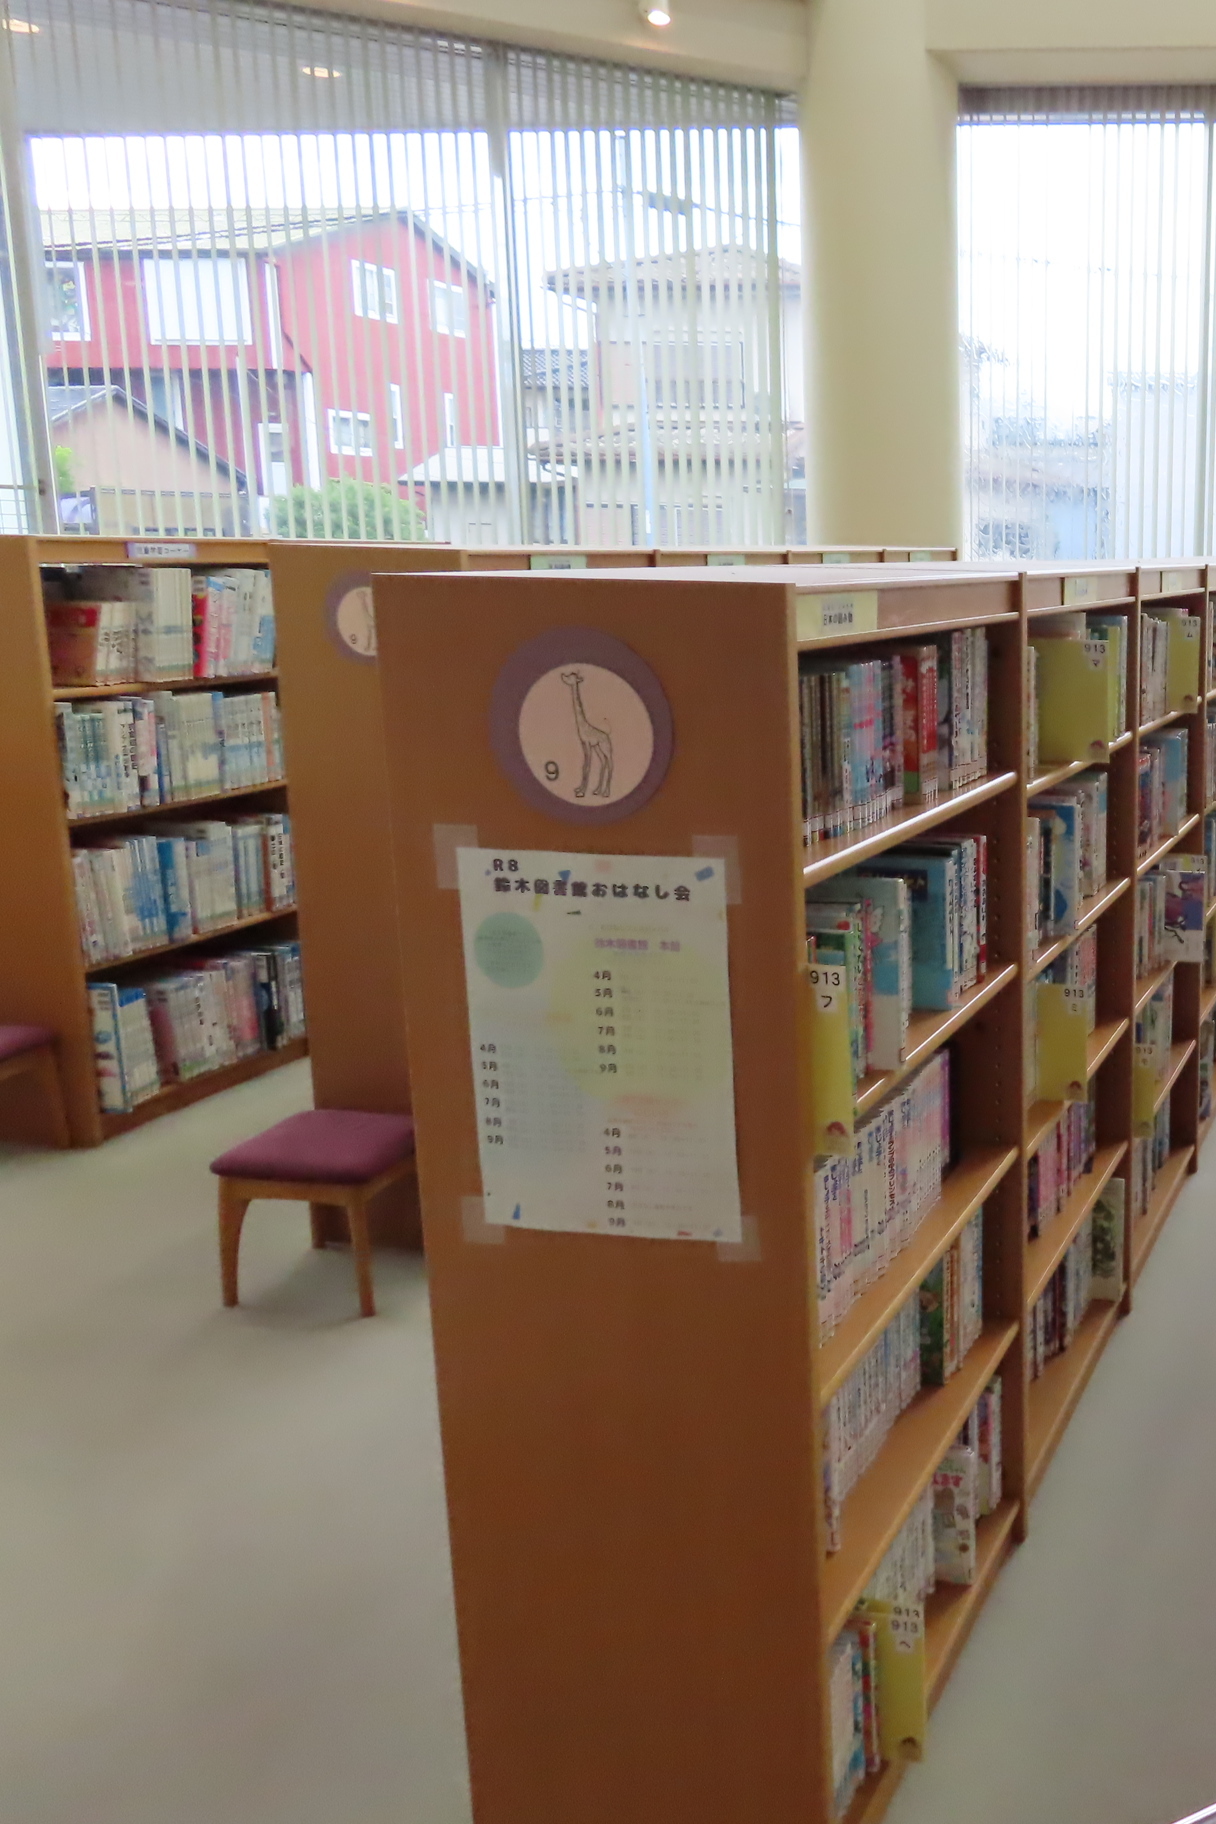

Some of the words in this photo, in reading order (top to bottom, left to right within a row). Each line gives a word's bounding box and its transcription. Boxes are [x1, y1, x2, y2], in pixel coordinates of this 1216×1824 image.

[1181, 619, 1198, 628] 913
[1084, 643, 1106, 654] 913
[544, 761, 560, 781] 9
[494, 876, 691, 902] 鈴木図書館おはなし会
[593, 970, 612, 981] 4月
[810, 970, 840, 986] 913
[594, 988, 613, 999] 5月
[1064, 988, 1084, 998] 913
[821, 995, 832, 1008] フ
[595, 1006, 614, 1018] 6月
[597, 1026, 616, 1037] 7月
[480, 1043, 497, 1054] 4月
[598, 1044, 617, 1055] 8月
[482, 1061, 498, 1072] 5月
[599, 1063, 618, 1074] 9月
[483, 1079, 499, 1090] 6月
[485, 1097, 501, 1108] 7月
[603, 1127, 621, 1138] 4月
[487, 1134, 504, 1145] 9月
[605, 1145, 622, 1156] 5月
[605, 1163, 623, 1174] 6月
[606, 1182, 624, 1192] 7月
[608, 1217, 626, 1228] 9月
[892, 1620, 918, 1633] 913
